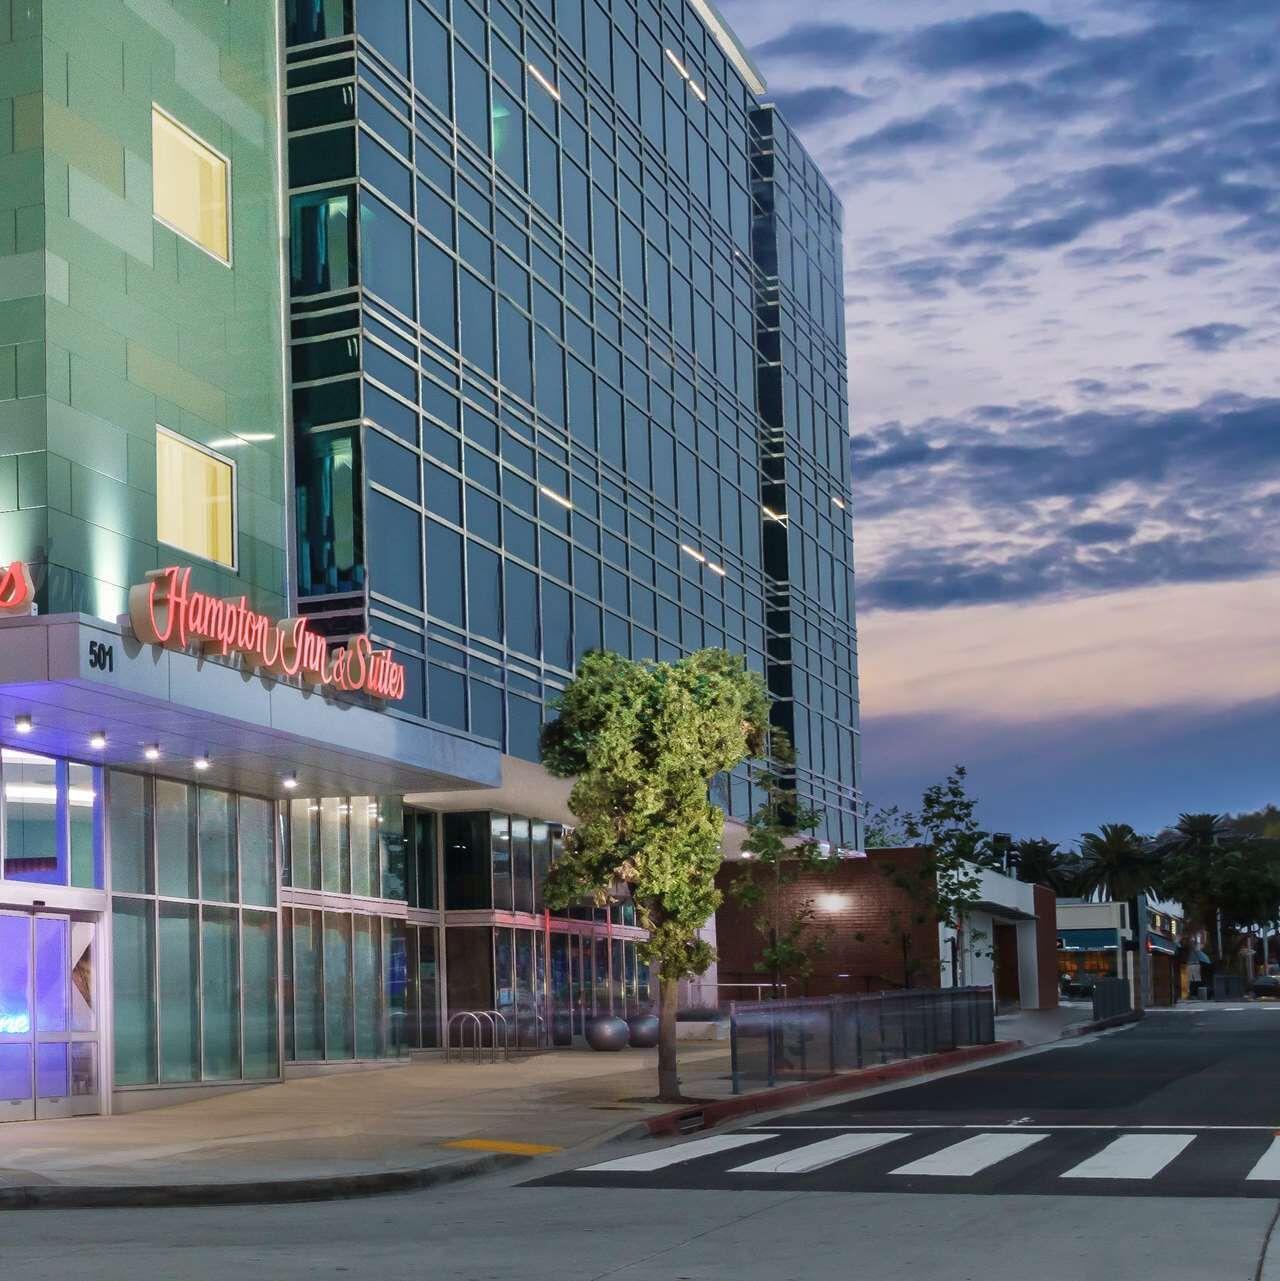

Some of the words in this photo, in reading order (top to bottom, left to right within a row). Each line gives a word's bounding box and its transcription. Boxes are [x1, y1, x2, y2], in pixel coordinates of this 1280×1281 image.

[88, 640, 114, 673] 501
[149, 566, 280, 666] Hampton
[280, 616, 333, 684] Inn
[332, 646, 348, 690] &
[346, 634, 405, 700] Suites
